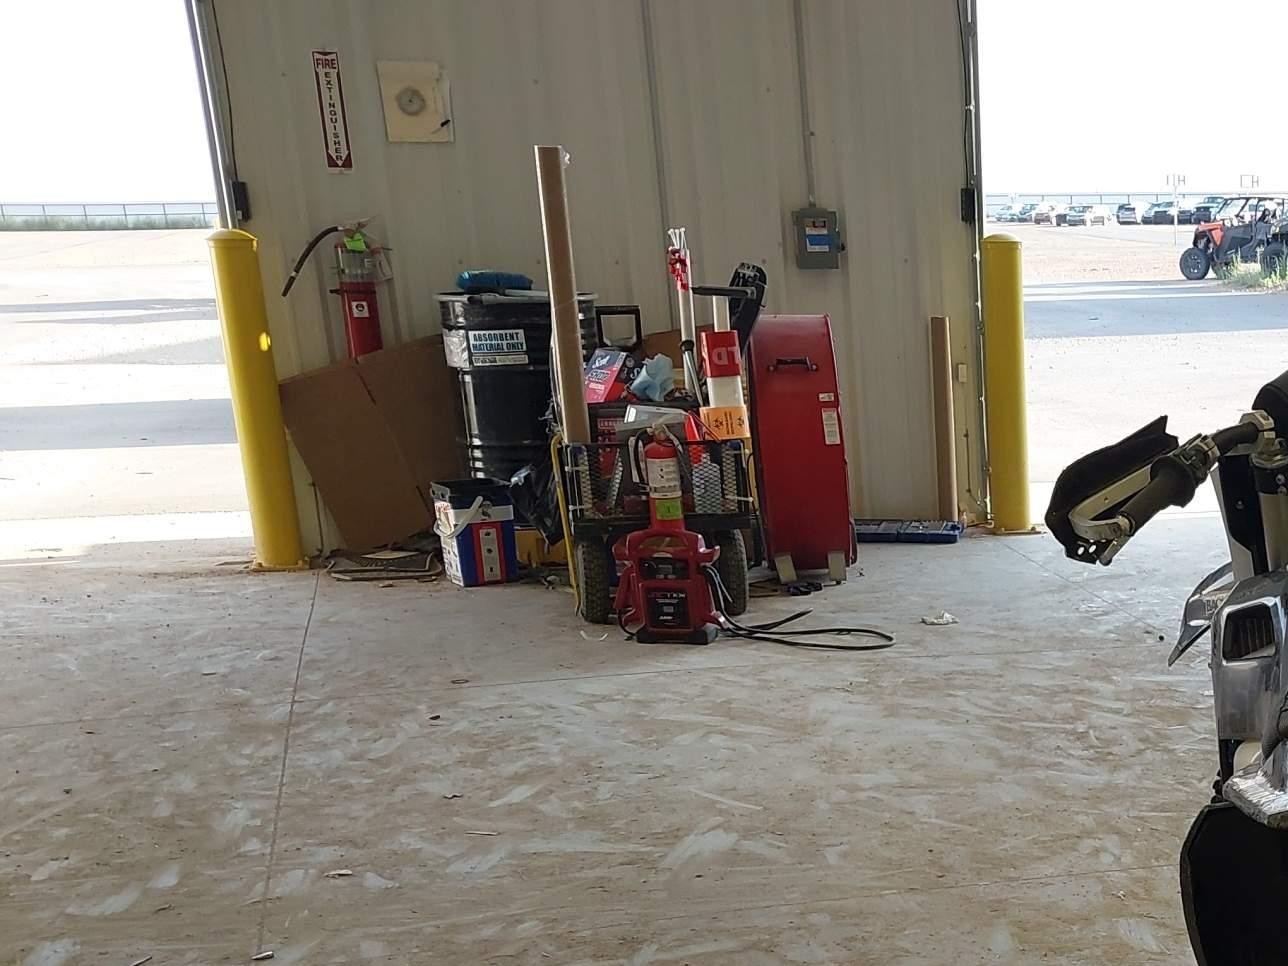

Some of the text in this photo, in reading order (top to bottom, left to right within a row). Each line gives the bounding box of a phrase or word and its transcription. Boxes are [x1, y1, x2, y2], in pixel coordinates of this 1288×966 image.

[316, 58, 337, 70] FIRE
[324, 72, 343, 161] EXTINGUISHER
[473, 332, 520, 342] ABSORBENT
[472, 342, 524, 352] MATERIAL ONLY
